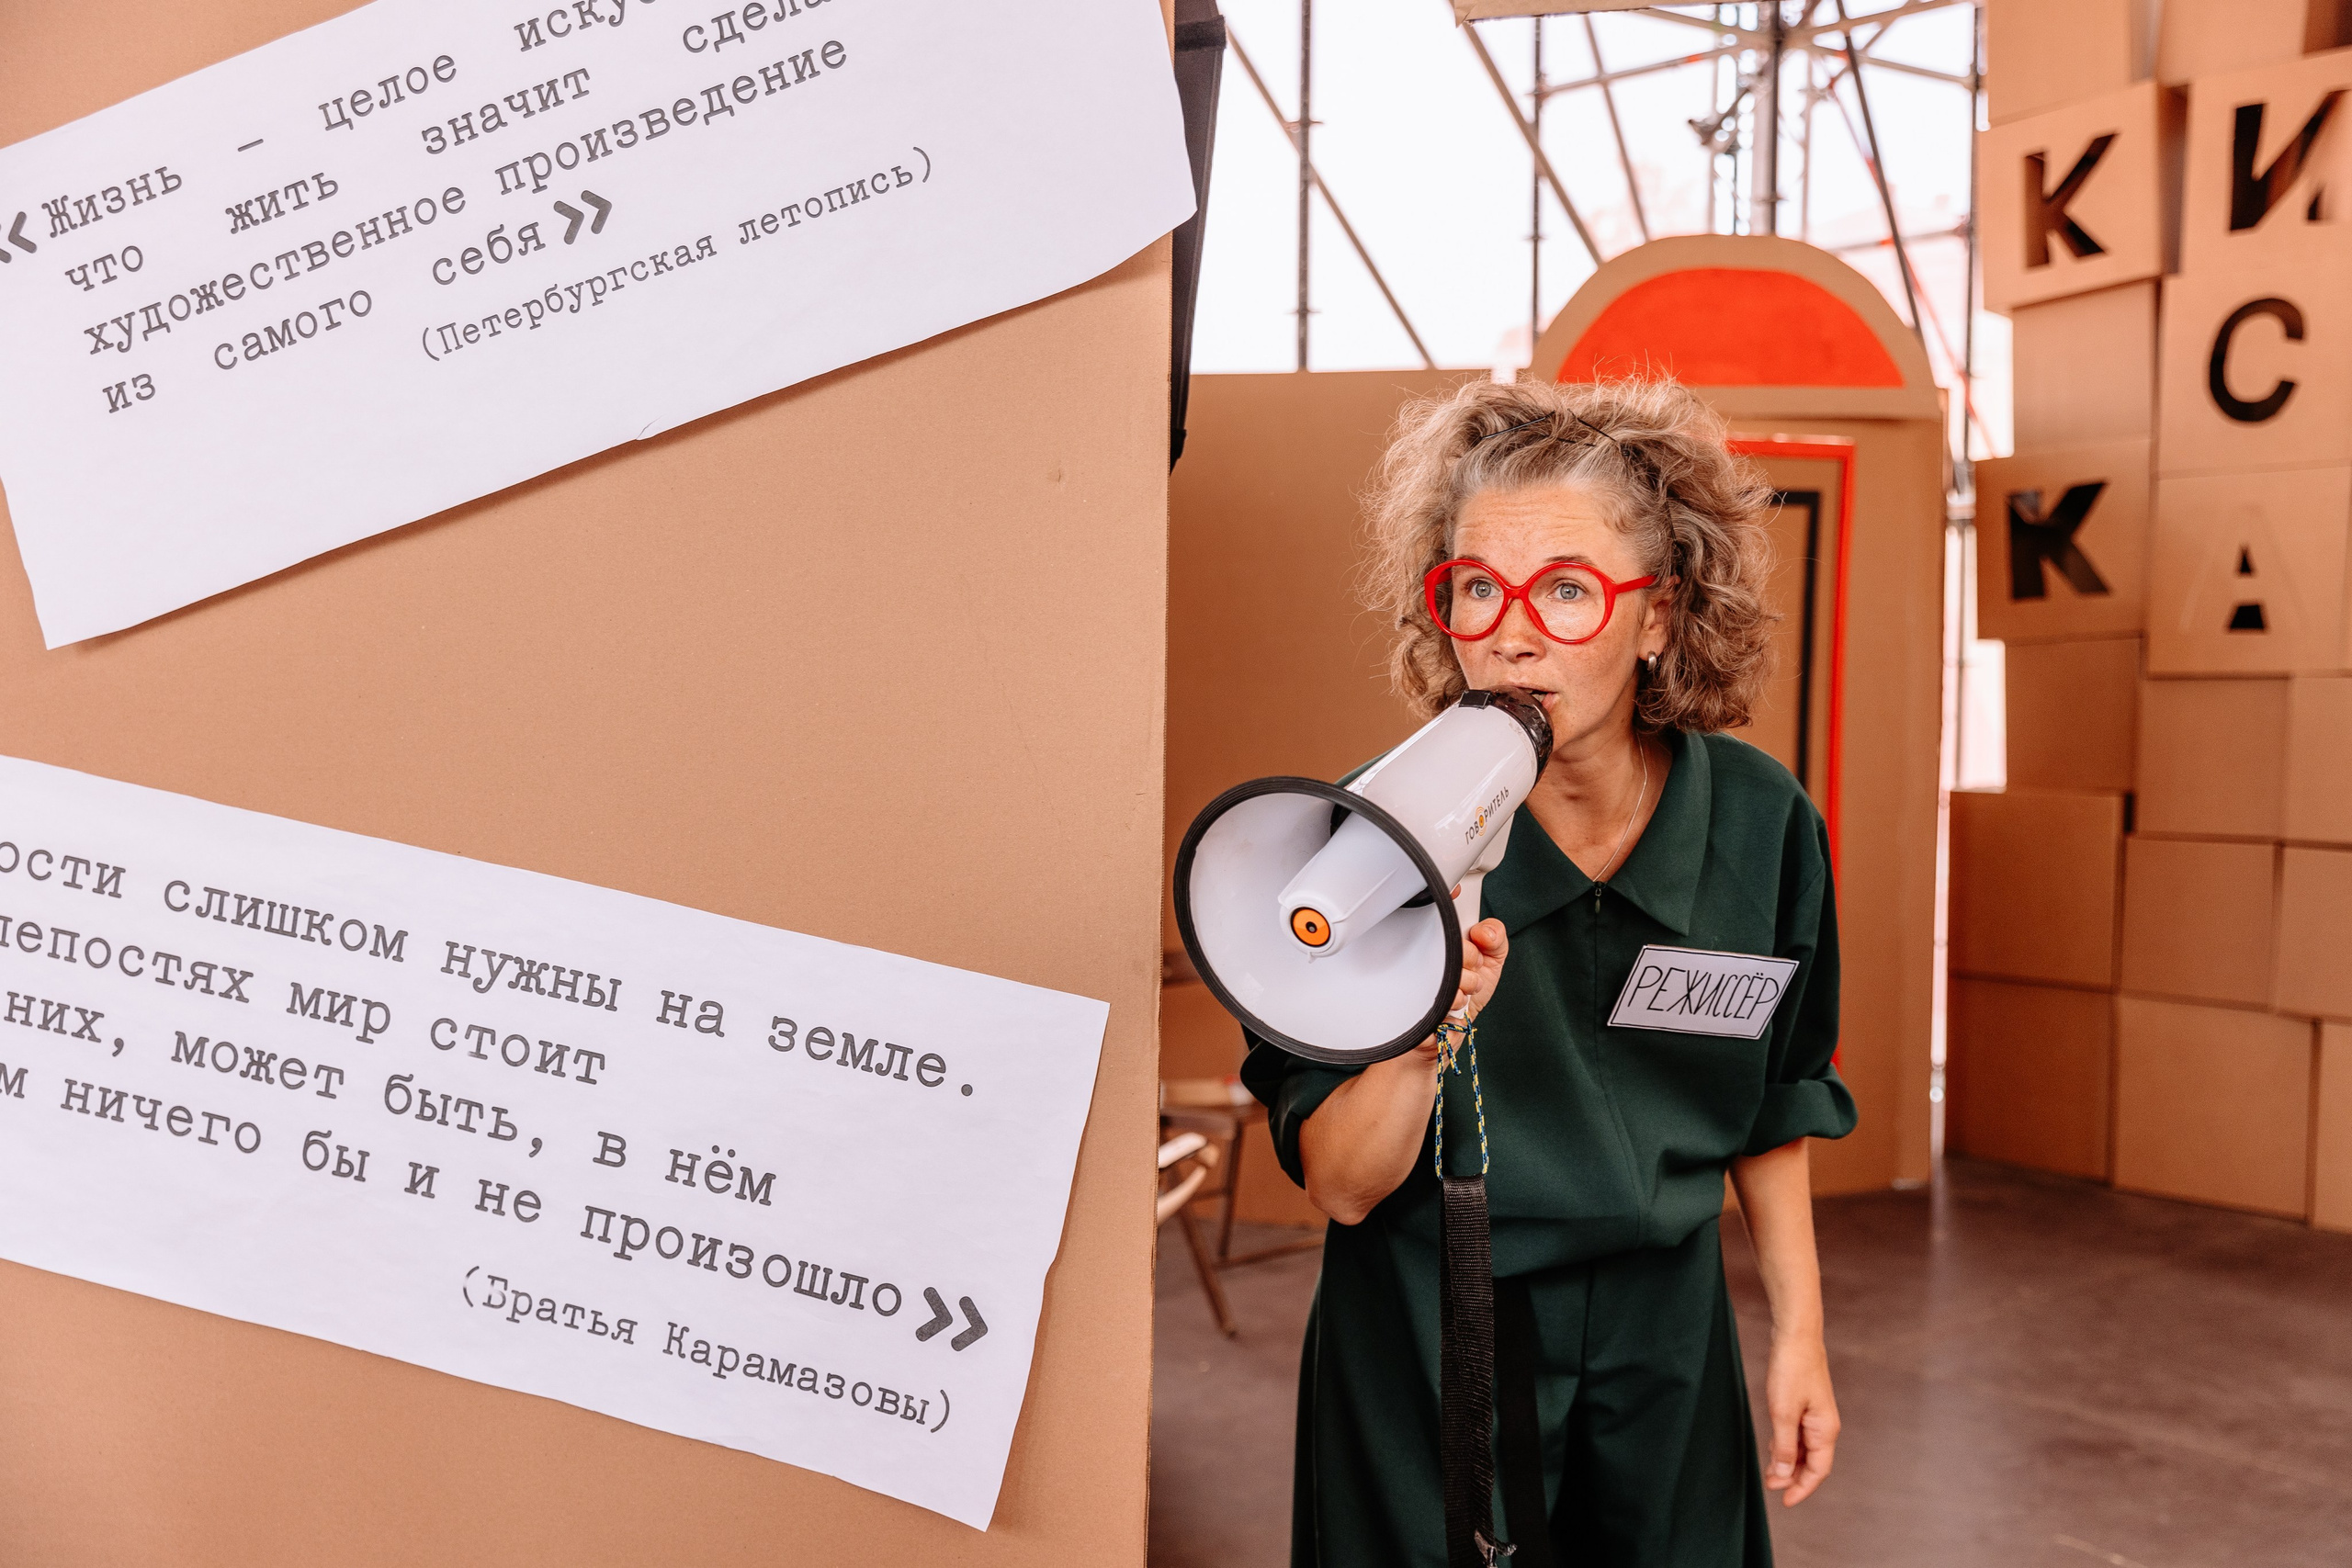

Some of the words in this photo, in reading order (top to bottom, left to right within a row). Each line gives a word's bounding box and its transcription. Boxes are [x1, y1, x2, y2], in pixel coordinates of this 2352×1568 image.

[318, 54, 458, 131] целое
[513, 0, 656, 52] иску
[64, 245, 144, 292] что
[224, 172, 339, 235] жить
[421, 67, 591, 155] значит
[682, 0, 831, 54] сдел
[83, 186, 467, 355] художественное
[494, 39, 847, 196] произведение
[2022, 130, 2121, 269] К
[2227, 87, 2352, 236] И
[101, 373, 156, 414] из
[213, 298, 372, 370] самого
[432, 189, 613, 286] себя»
[422, 234, 718, 362] (Петербургская
[738, 146, 932, 245] летопись)
[2207, 296, 2306, 427] С
[2007, 479, 2112, 601] К
[1464, 786, 1510, 845] ГОВОРИТЕЛЬ
[164, 879, 409, 963] слишком
[440, 940, 623, 1012] нужны
[655, 989, 726, 1038] на
[767, 1015, 974, 1098] земле.
[286, 981, 391, 1045] мир
[430, 1017, 605, 1086] стоит
[1627, 964, 1780, 1021] РЕЖИССЁР
[3, 990, 125, 1058] них,
[170, 1030, 345, 1100] может
[383, 1073, 543, 1158] быть,
[592, 1130, 627, 1168] в
[664, 1145, 777, 1207] нём
[60, 1077, 262, 1155] ничего
[301, 1129, 371, 1183] бы
[403, 1161, 441, 1200] и
[474, 1179, 542, 1224] не
[580, 1204, 989, 1352] произошло»
[462, 1265, 639, 1346] (Братья
[662, 1321, 951, 1434] Карамазовы)
